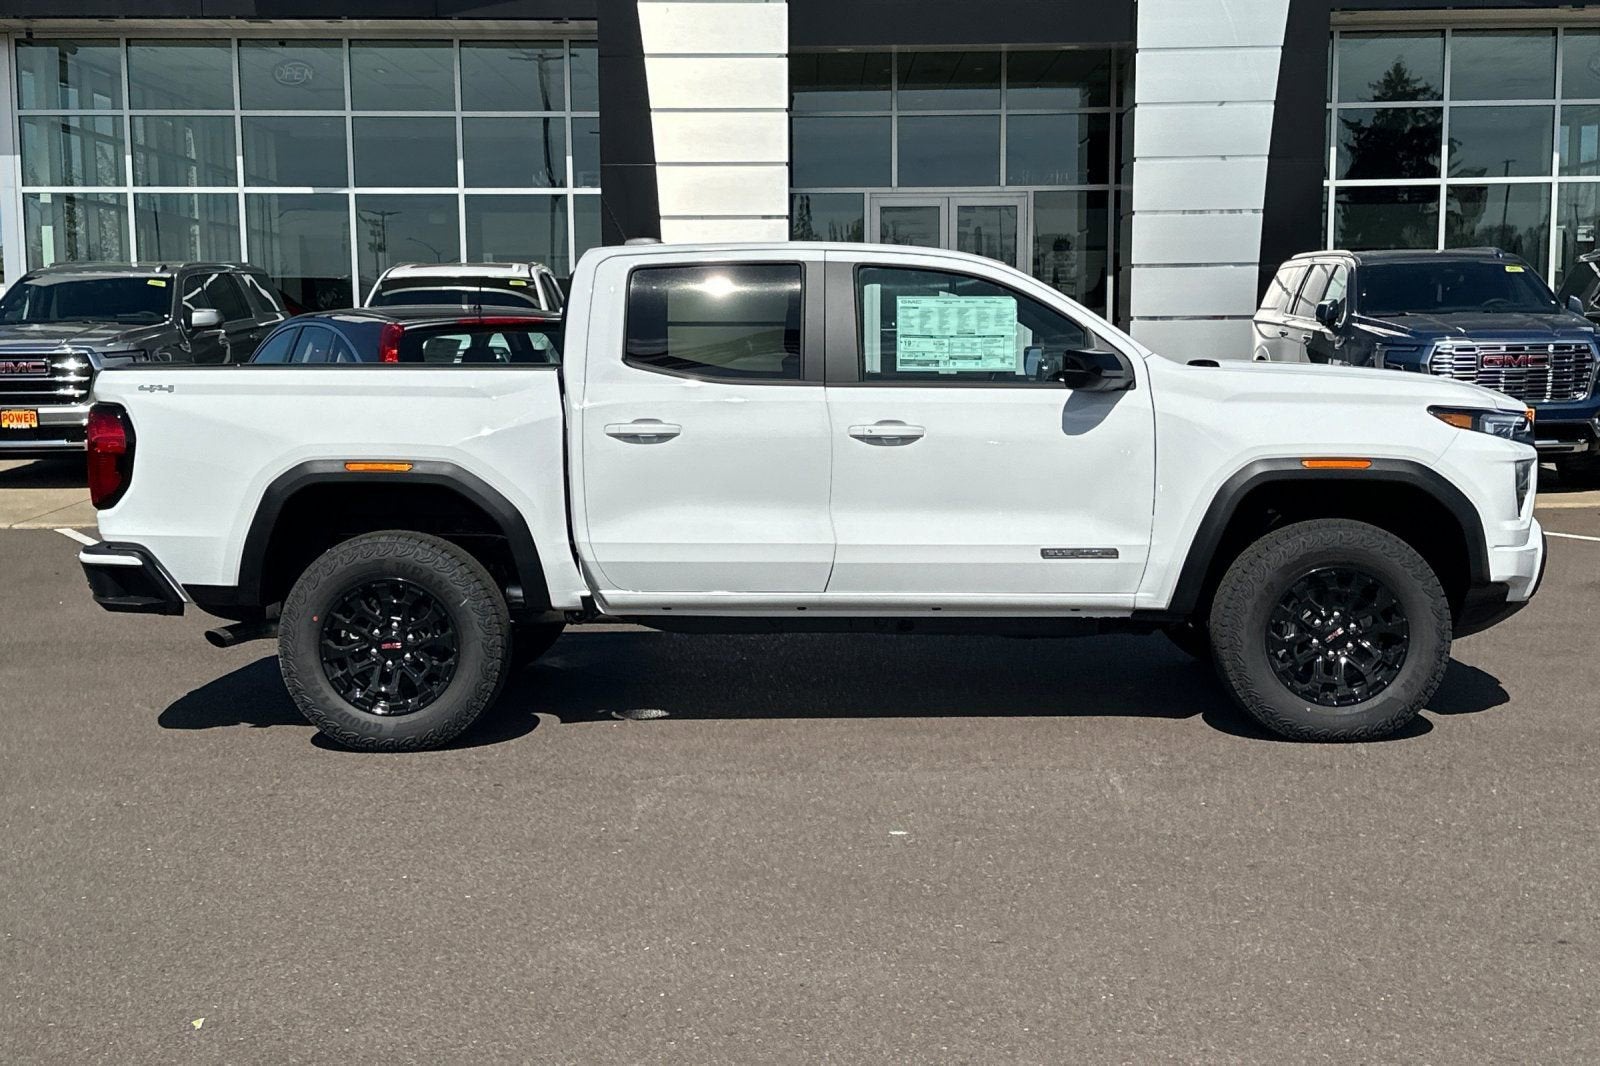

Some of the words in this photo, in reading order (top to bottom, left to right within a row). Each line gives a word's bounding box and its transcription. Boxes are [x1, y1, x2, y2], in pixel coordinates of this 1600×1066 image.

[274, 65, 313, 80] OPEN
[0, 361, 46, 373] MC
[1482, 354, 1549, 368] GMC
[2, 413, 36, 424] POWER
